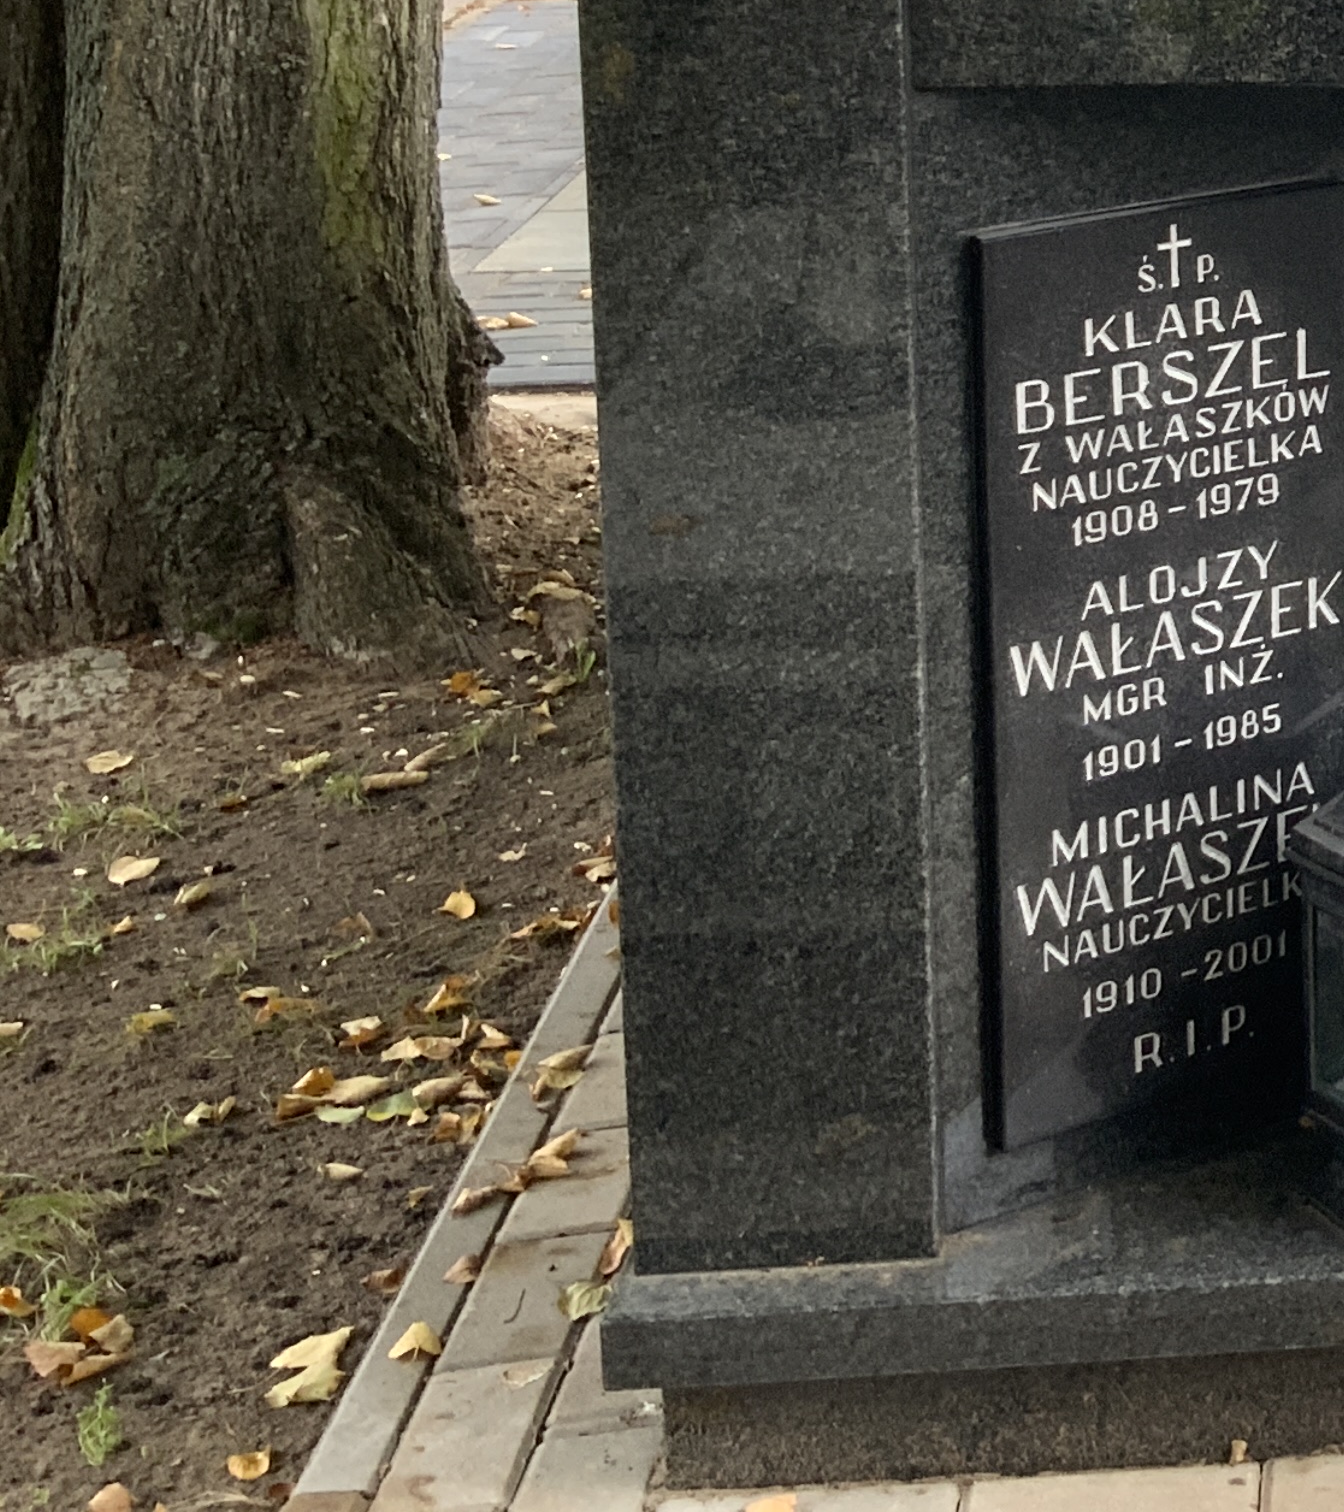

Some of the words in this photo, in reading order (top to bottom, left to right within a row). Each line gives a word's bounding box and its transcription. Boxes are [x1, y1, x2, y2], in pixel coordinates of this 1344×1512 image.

[1083, 289, 1263, 357] KLARA
[1015, 327, 1331, 435] BERSZEL
[1018, 442, 1041, 475] Z
[1065, 381, 1330, 464] WAŁASZKÓW
[1032, 424, 1323, 512] NAUCZYCIELKA
[1081, 540, 1278, 621] ALOJZY
[1010, 570, 1342, 697] WAŁASZEK
[1084, 677, 1167, 726] MGR
[1204, 643, 1283, 695] INŻ.
[1051, 761, 1315, 867] MICHALINA
[1017, 802, 1320, 936] WAŁASZE
[1043, 871, 1303, 973] NAUCZYCIELK
